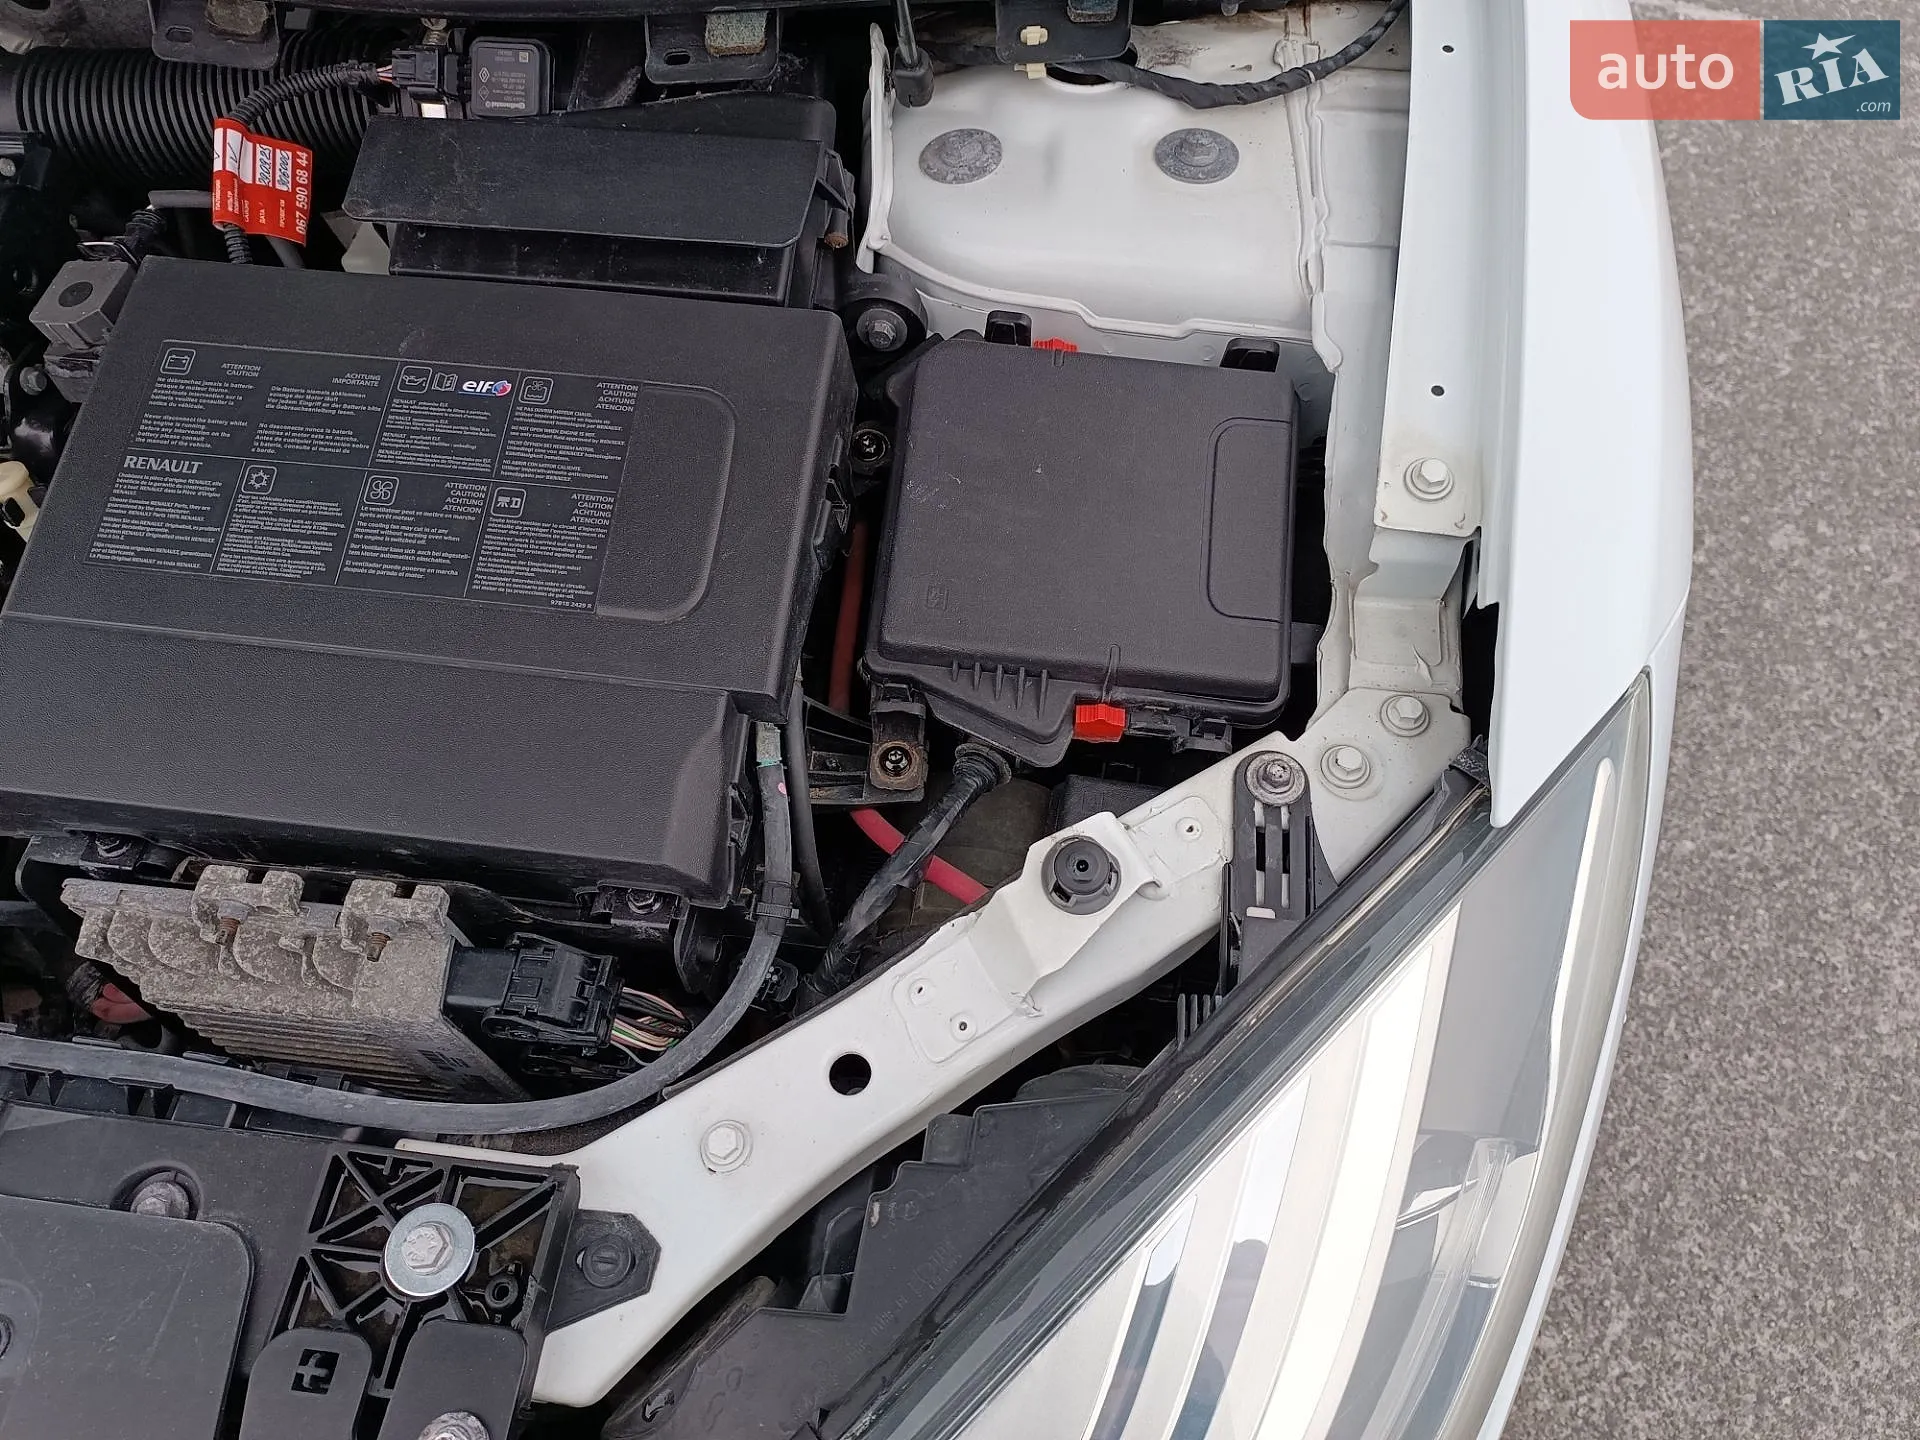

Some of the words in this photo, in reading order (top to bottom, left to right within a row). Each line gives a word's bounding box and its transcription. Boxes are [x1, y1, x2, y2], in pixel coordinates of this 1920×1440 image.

[296, 151, 308, 167] 44
[296, 169, 308, 185] 68
[296, 187, 308, 210] 590
[296, 210, 307, 235] 067
[221, 363, 262, 371] ATTENTION
[226, 369, 259, 377] CAUTION
[344, 373, 381, 381] ACHTUNG
[596, 382, 639, 392] ATTENTION
[602, 389, 638, 398] CAUTION
[598, 396, 636, 405] ACHTUNG
[124, 455, 203, 474] RENAULT
[444, 482, 488, 491] ATTENTION
[450, 489, 486, 498] CAUTION
[570, 493, 615, 503] ATTENTION
[445, 497, 484, 506] ACHTUNG
[577, 501, 613, 510] CAUTION
[441, 504, 482, 514] ATENCION
[572, 508, 612, 518] ACHTUNG
[570, 516, 610, 526] ATENCION
